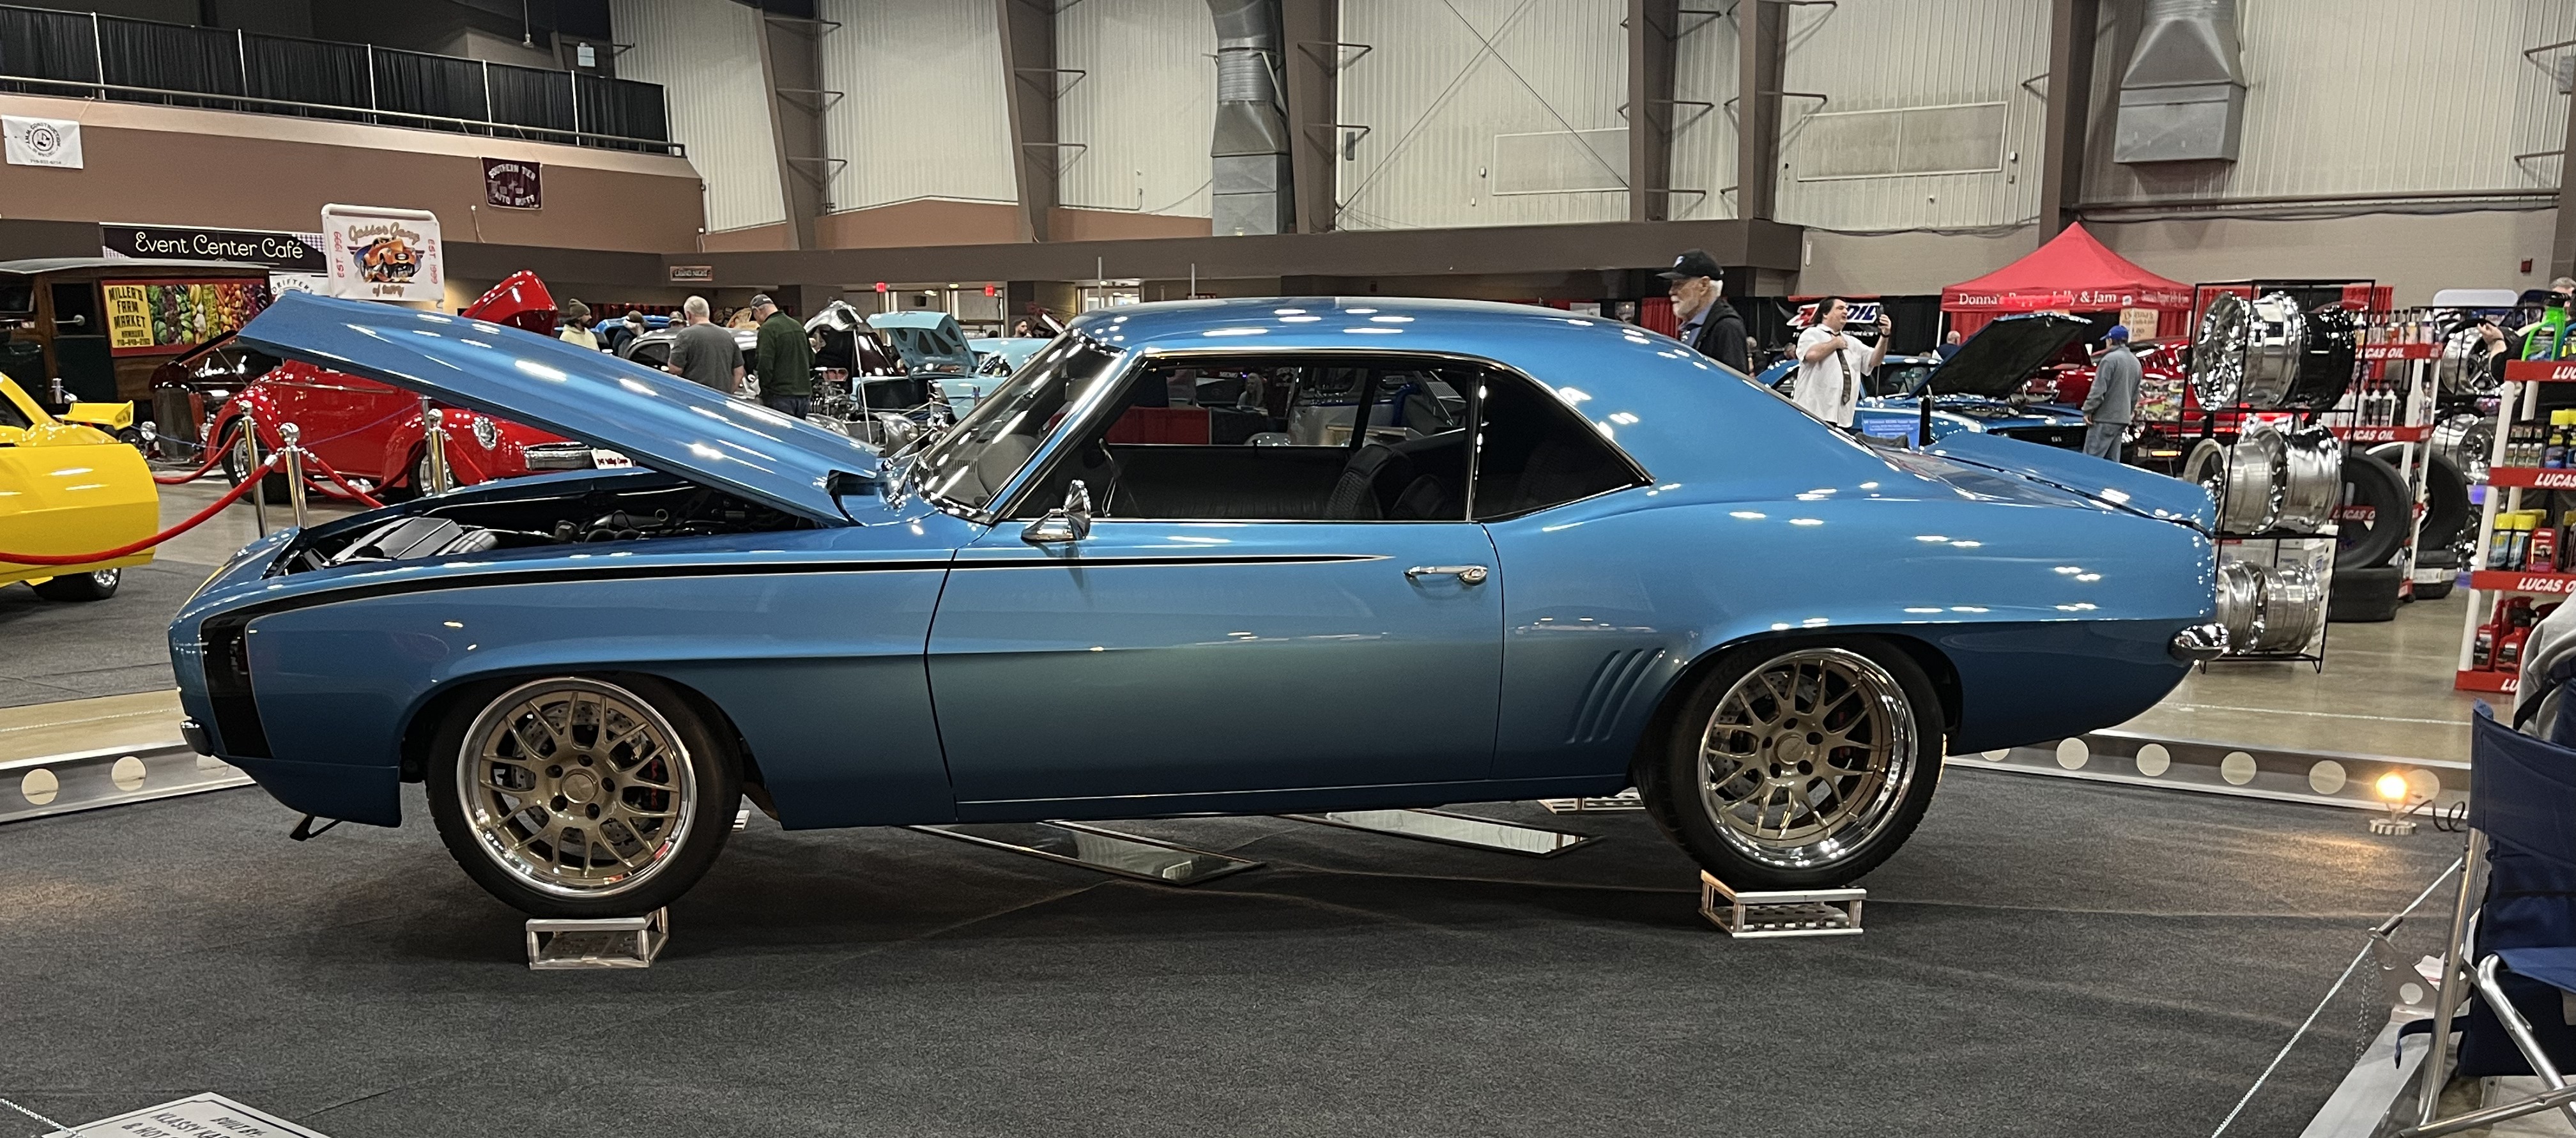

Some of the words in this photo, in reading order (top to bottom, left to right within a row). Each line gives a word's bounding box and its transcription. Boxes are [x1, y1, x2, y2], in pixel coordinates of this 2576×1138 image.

[489, 164, 519, 179] SOUTHERN
[521, 166, 535, 181] TIER
[494, 192, 510, 204] AUTO
[135, 231, 189, 254] Event
[193, 234, 257, 256] Center
[261, 238, 303, 259] Café
[334, 231, 342, 252] 1999
[2080, 291, 2090, 303] &
[2091, 291, 2117, 306] Jam
[117, 300, 139, 314] FARM
[114, 315, 145, 329] MARKET
[2387, 348, 2404, 358] OIL
[2377, 429, 2395, 441] OIL
[2517, 577, 2563, 592] LUCAS
[150, 1112, 208, 1133] KLASSY
[209, 1117, 251, 1130] BUILT
[132, 1126, 171, 1138] HOT
